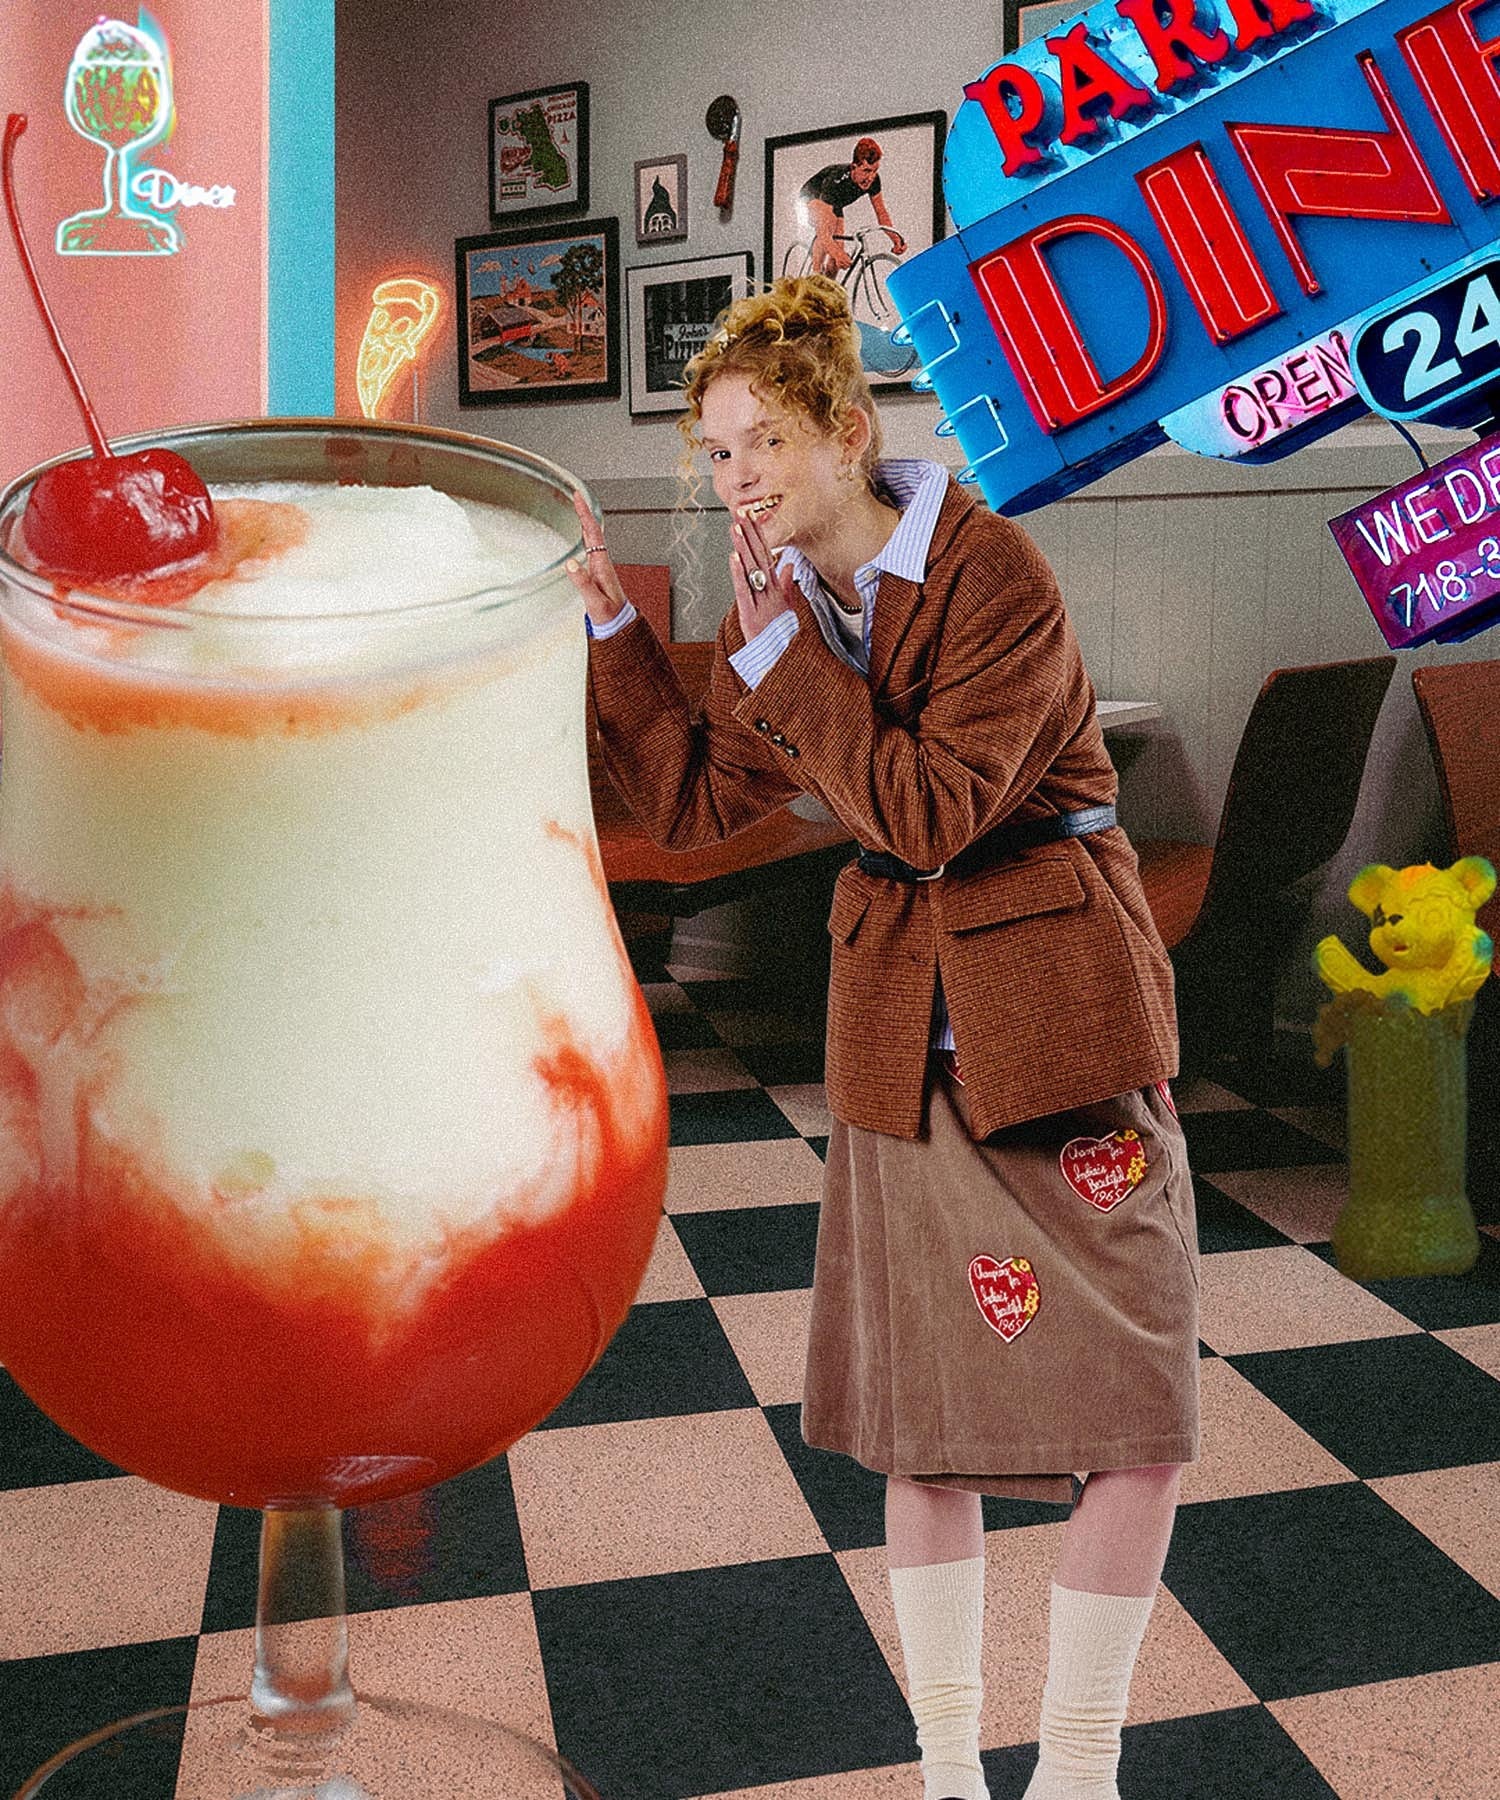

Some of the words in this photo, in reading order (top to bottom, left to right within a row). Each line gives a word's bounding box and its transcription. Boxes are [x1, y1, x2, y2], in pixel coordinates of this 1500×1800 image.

[546, 111, 577, 125] PIZZA
[1221, 329, 1357, 444] OPEN
[1354, 485, 1450, 567] WE
[1093, 1188, 1124, 1203] 1965
[998, 1319, 1023, 1332] 1965
